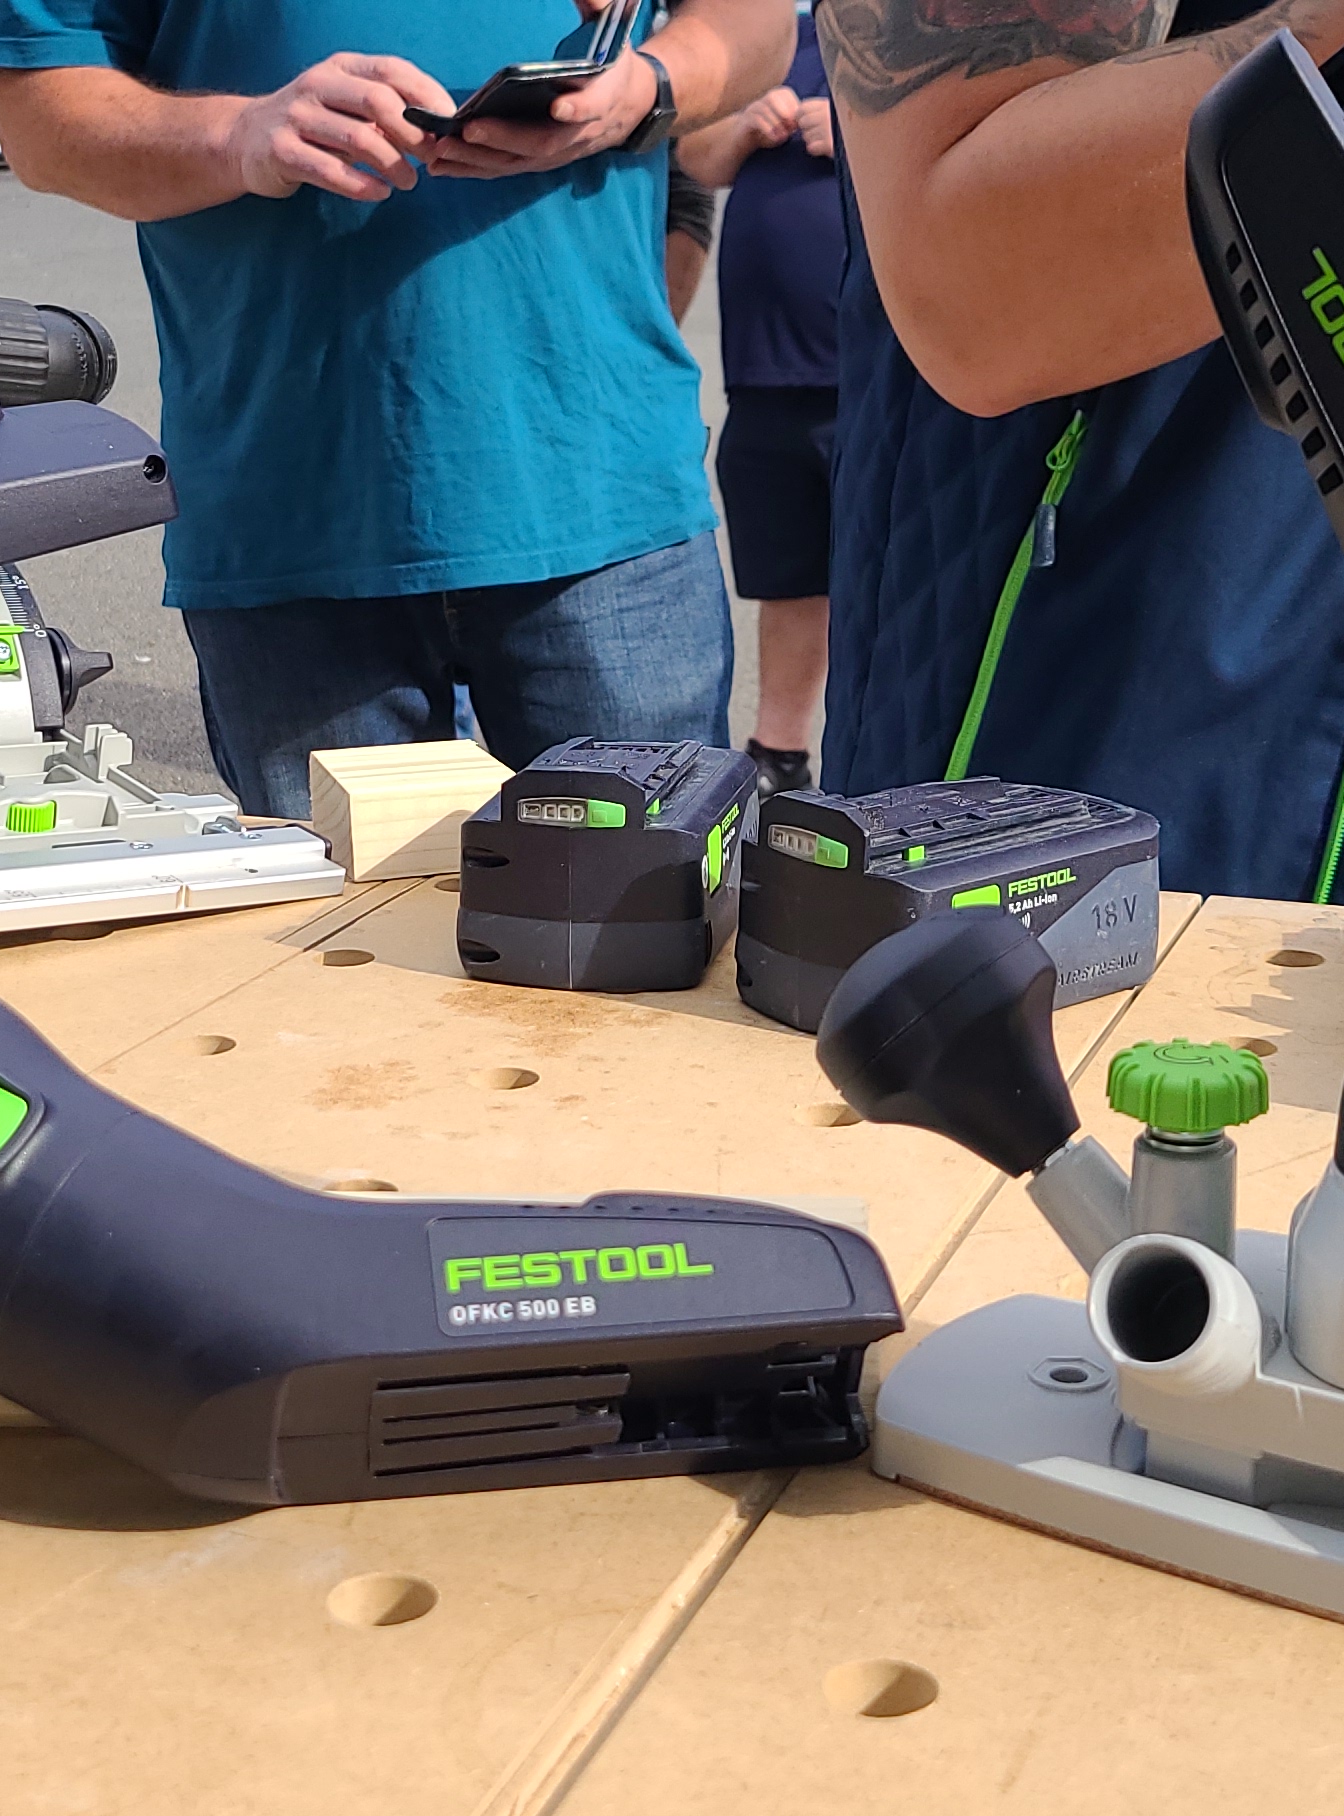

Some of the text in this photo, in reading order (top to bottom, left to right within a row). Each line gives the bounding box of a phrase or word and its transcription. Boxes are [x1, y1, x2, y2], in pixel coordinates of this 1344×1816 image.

[1008, 868, 1076, 897] FESTOOL
[1021, 898, 1033, 912] Ah
[1091, 893, 1138, 929] 18 V
[444, 1242, 714, 1293] FESTOOL
[448, 1295, 597, 1326] OFKC 500 EB
